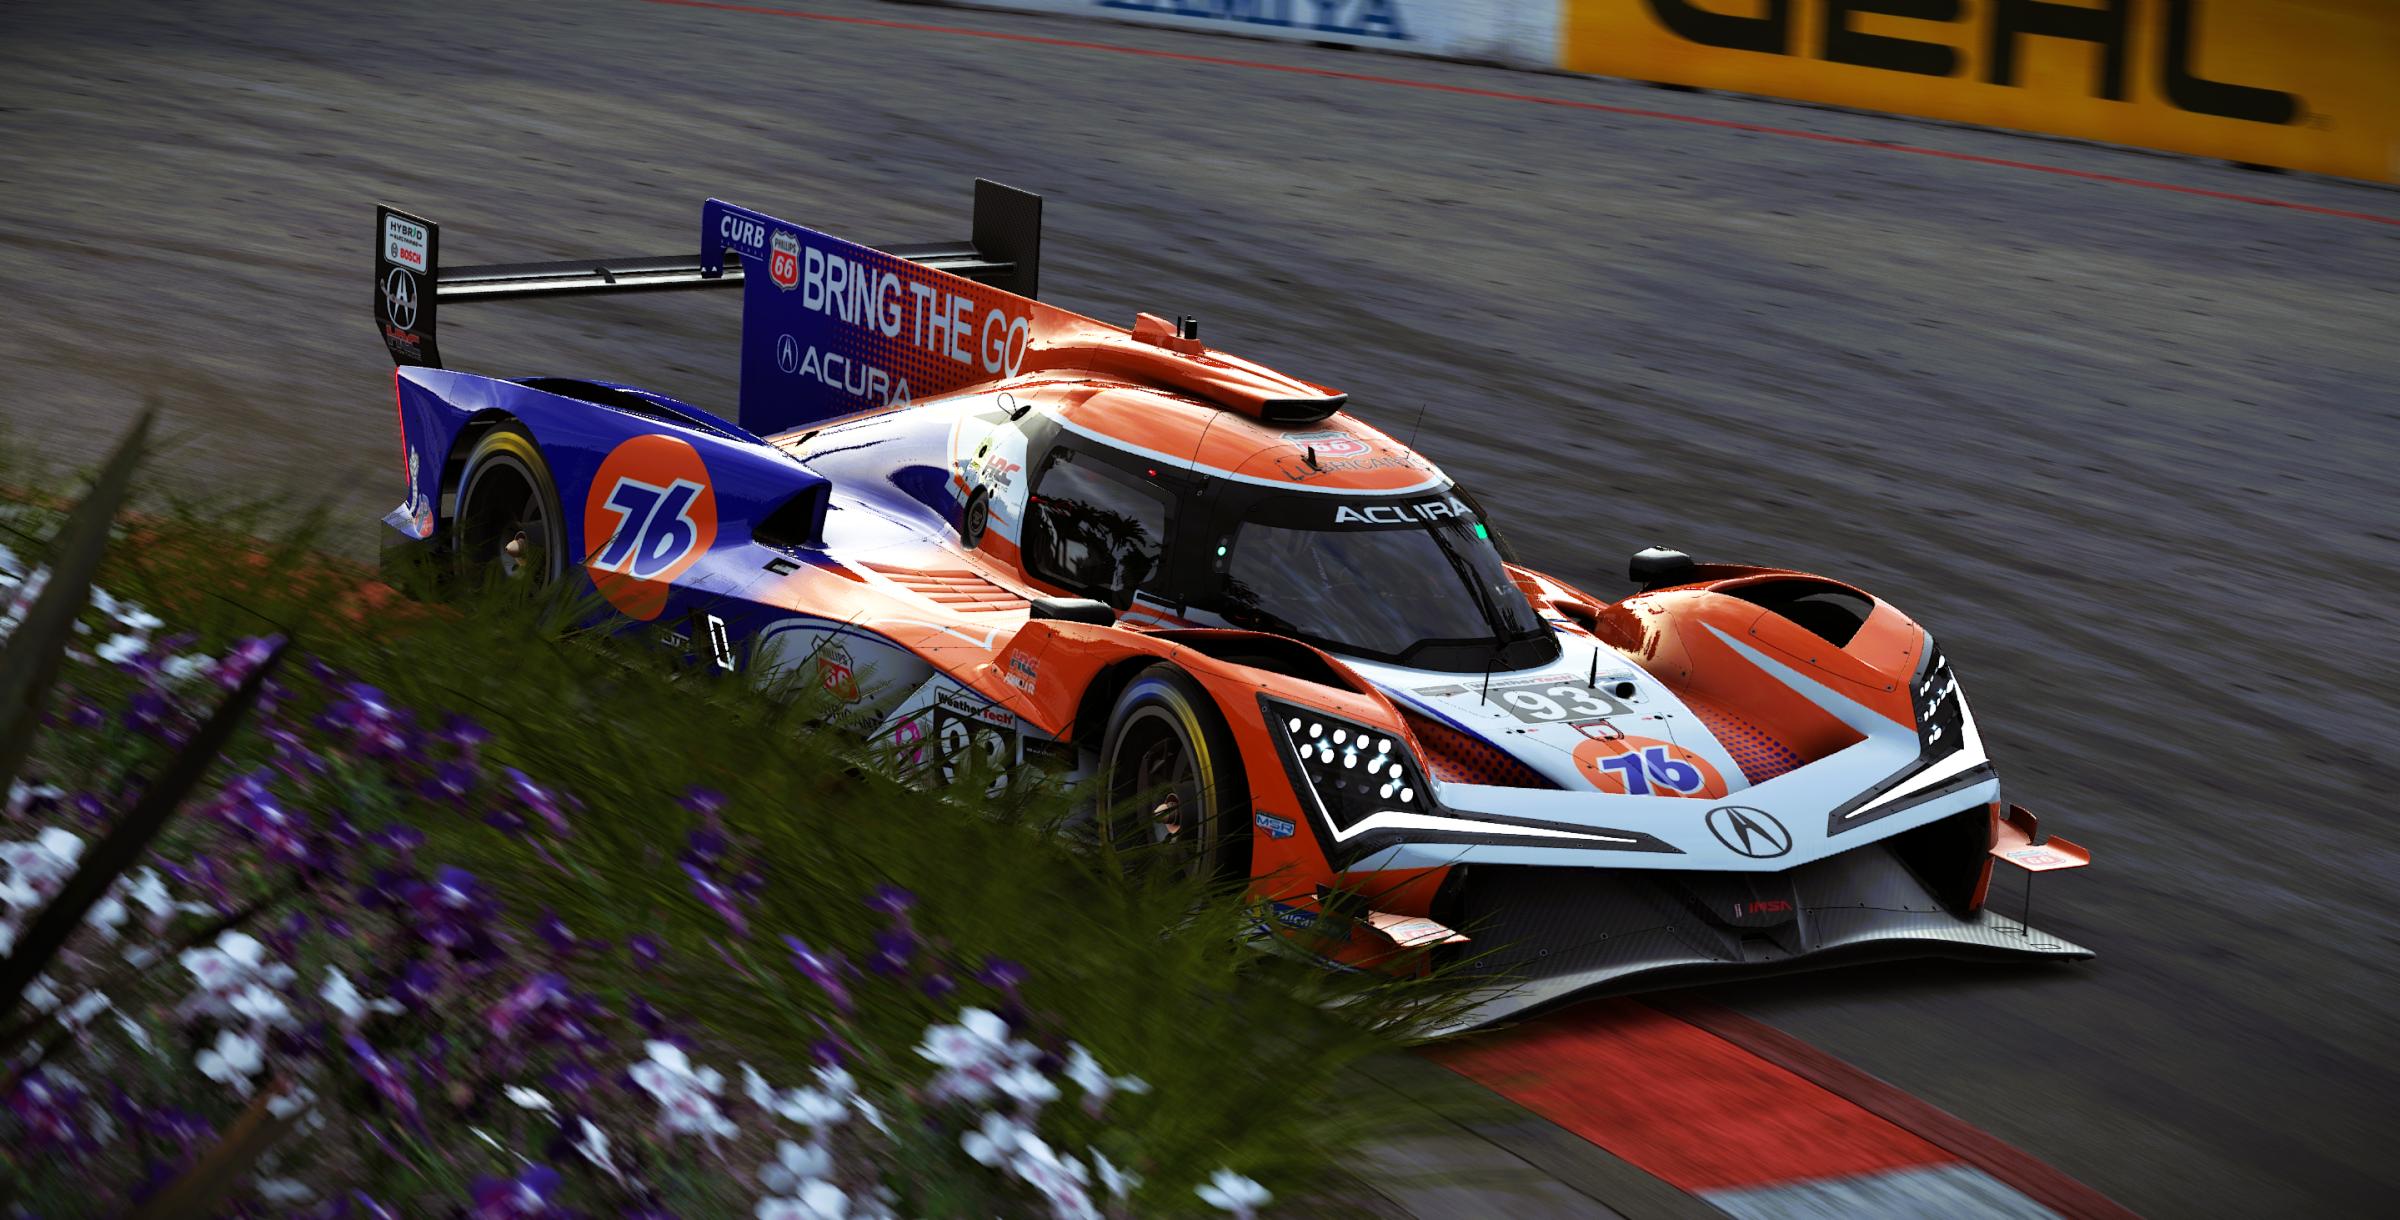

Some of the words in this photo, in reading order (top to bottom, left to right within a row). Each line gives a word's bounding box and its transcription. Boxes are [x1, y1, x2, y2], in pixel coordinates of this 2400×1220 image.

[720, 215, 765, 249] CURB
[774, 237, 797, 254] PHILLIPS
[400, 247, 422, 265] BOSCH
[775, 255, 794, 279] 66
[803, 246, 901, 337] BRING
[910, 281, 974, 364] THE
[982, 308, 1028, 379] GO
[800, 346, 911, 407] ACURA
[1312, 441, 1350, 452] 66
[1335, 497, 1473, 524] ACURA
[593, 476, 705, 580] 76
[937, 692, 1014, 725] WeatherTech
[1502, 687, 1613, 720] 93
[1597, 745, 1705, 795] 76
[1256, 814, 1294, 832] MSR
[1748, 900, 1793, 913] IMSA
